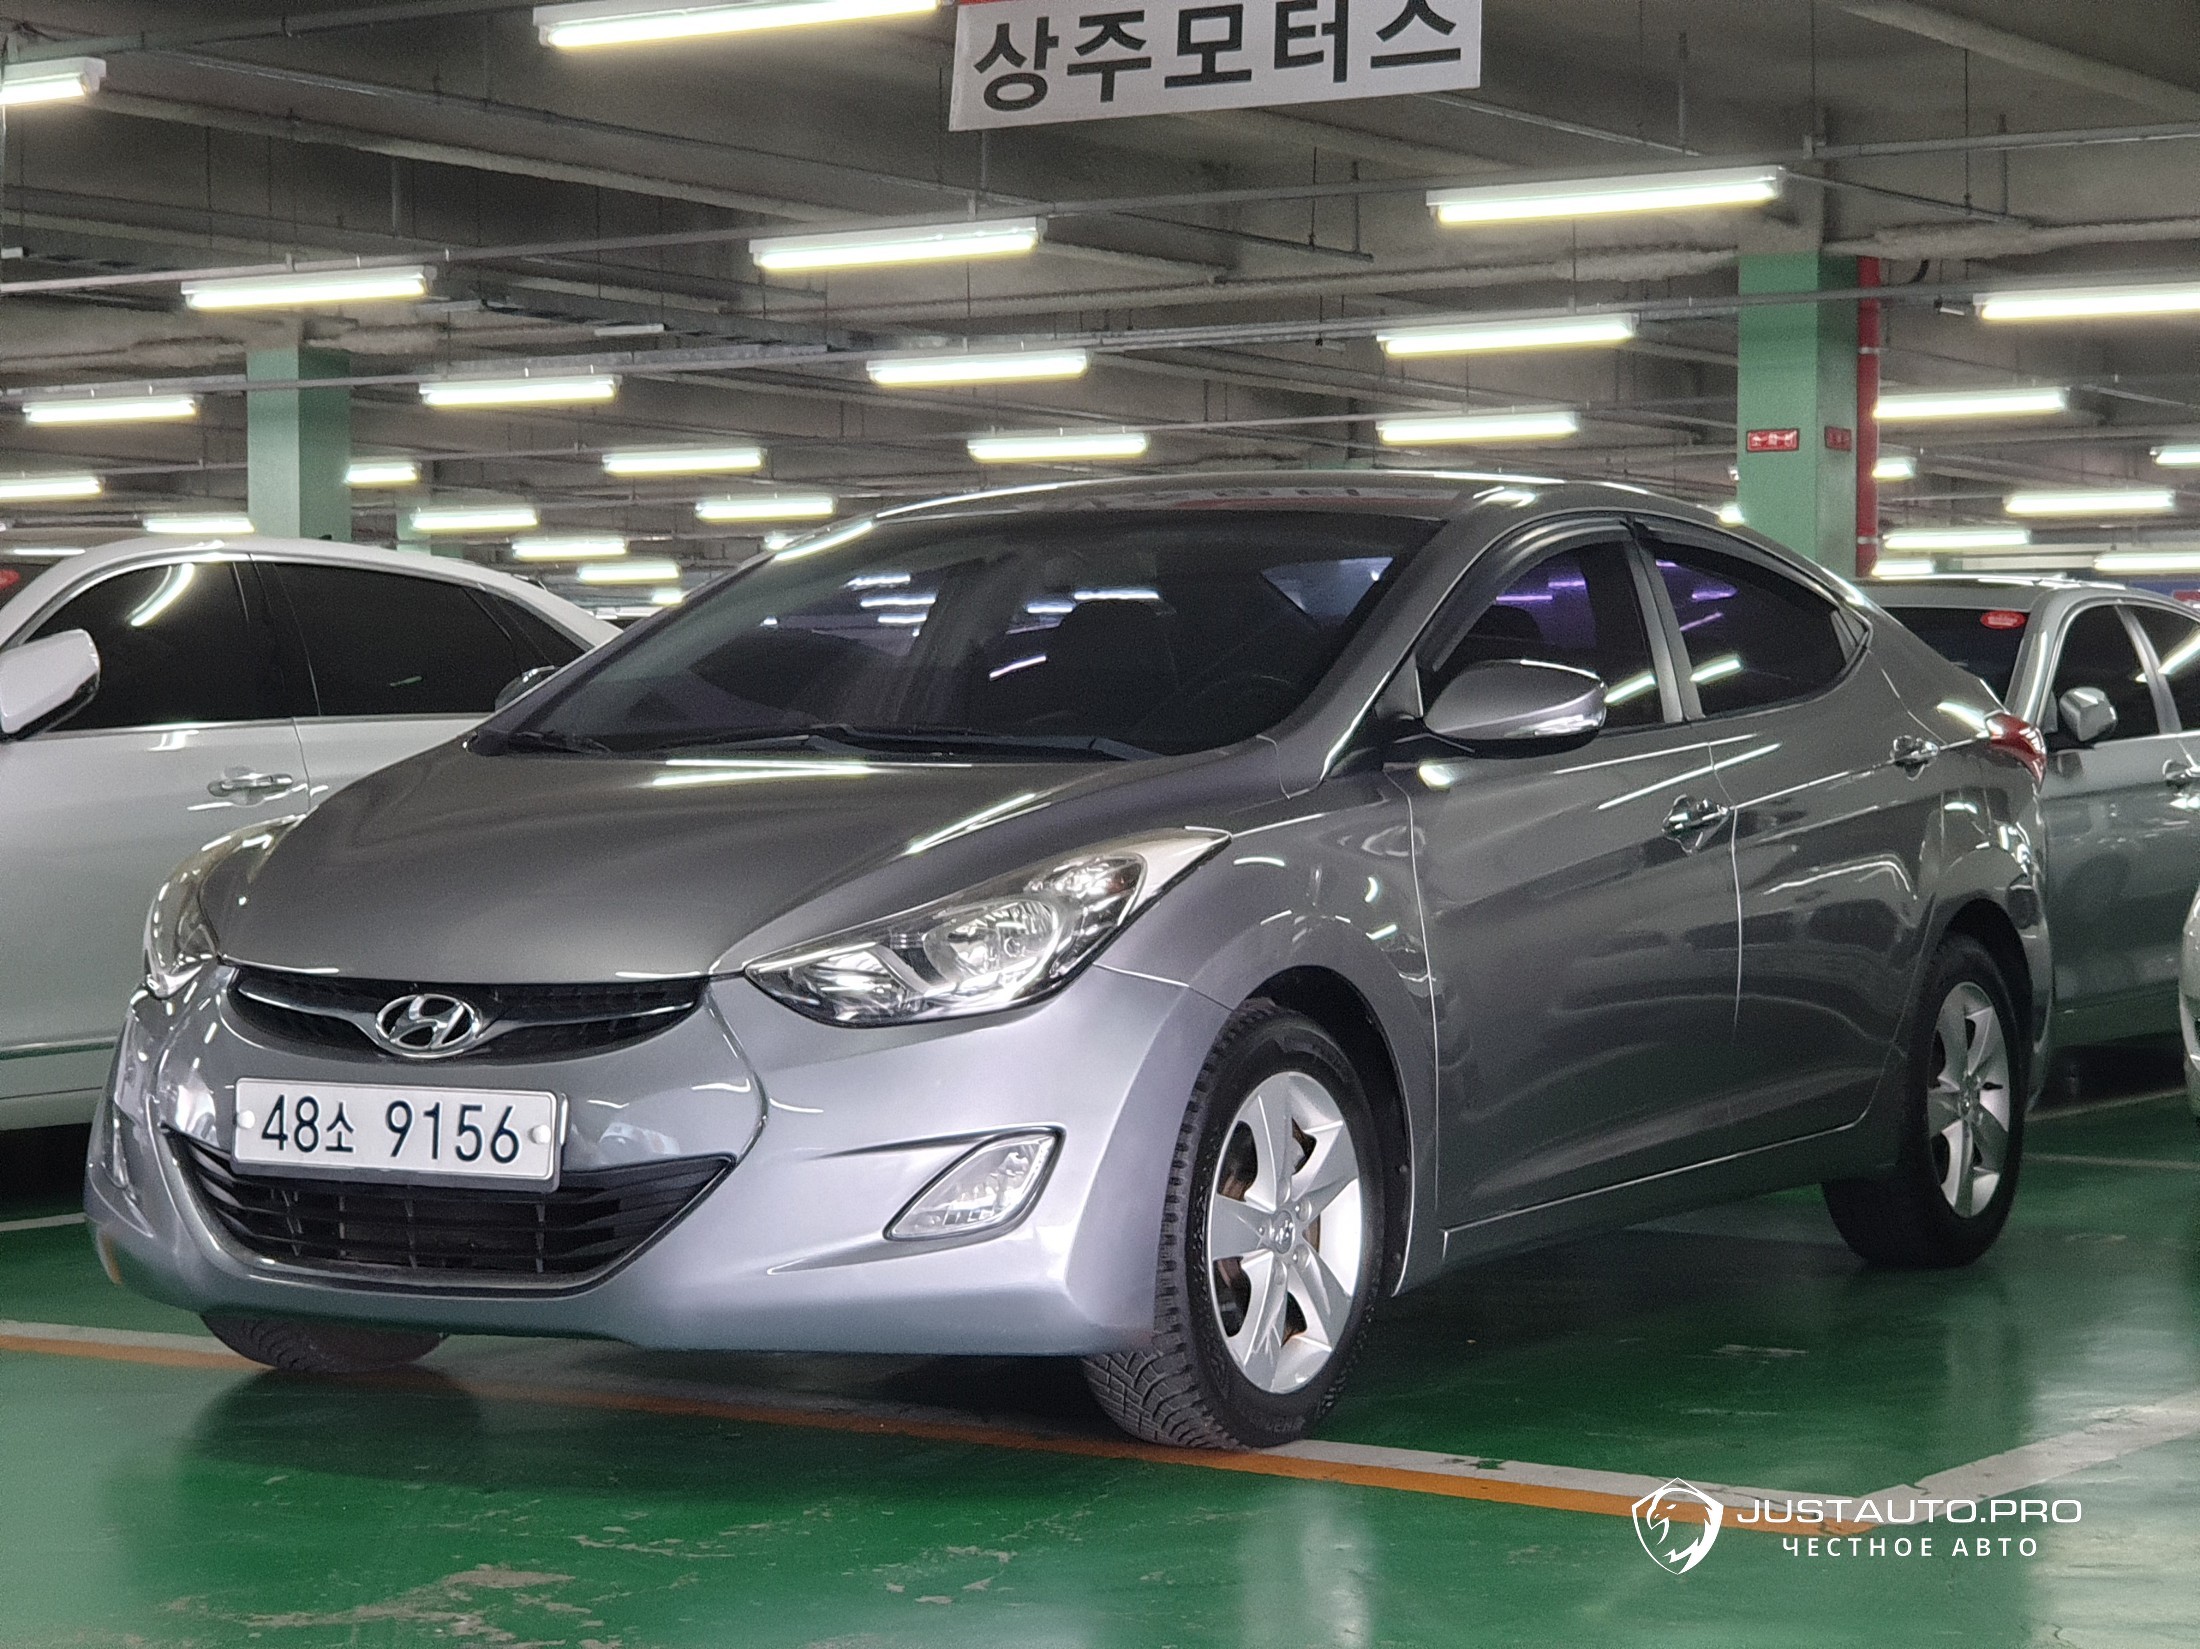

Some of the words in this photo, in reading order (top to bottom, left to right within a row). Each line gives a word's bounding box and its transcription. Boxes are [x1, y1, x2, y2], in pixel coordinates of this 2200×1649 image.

[974, 0, 1461, 112] 상주모터스
[261, 1094, 355, 1153] 48소
[386, 1100, 520, 1164] 9156
